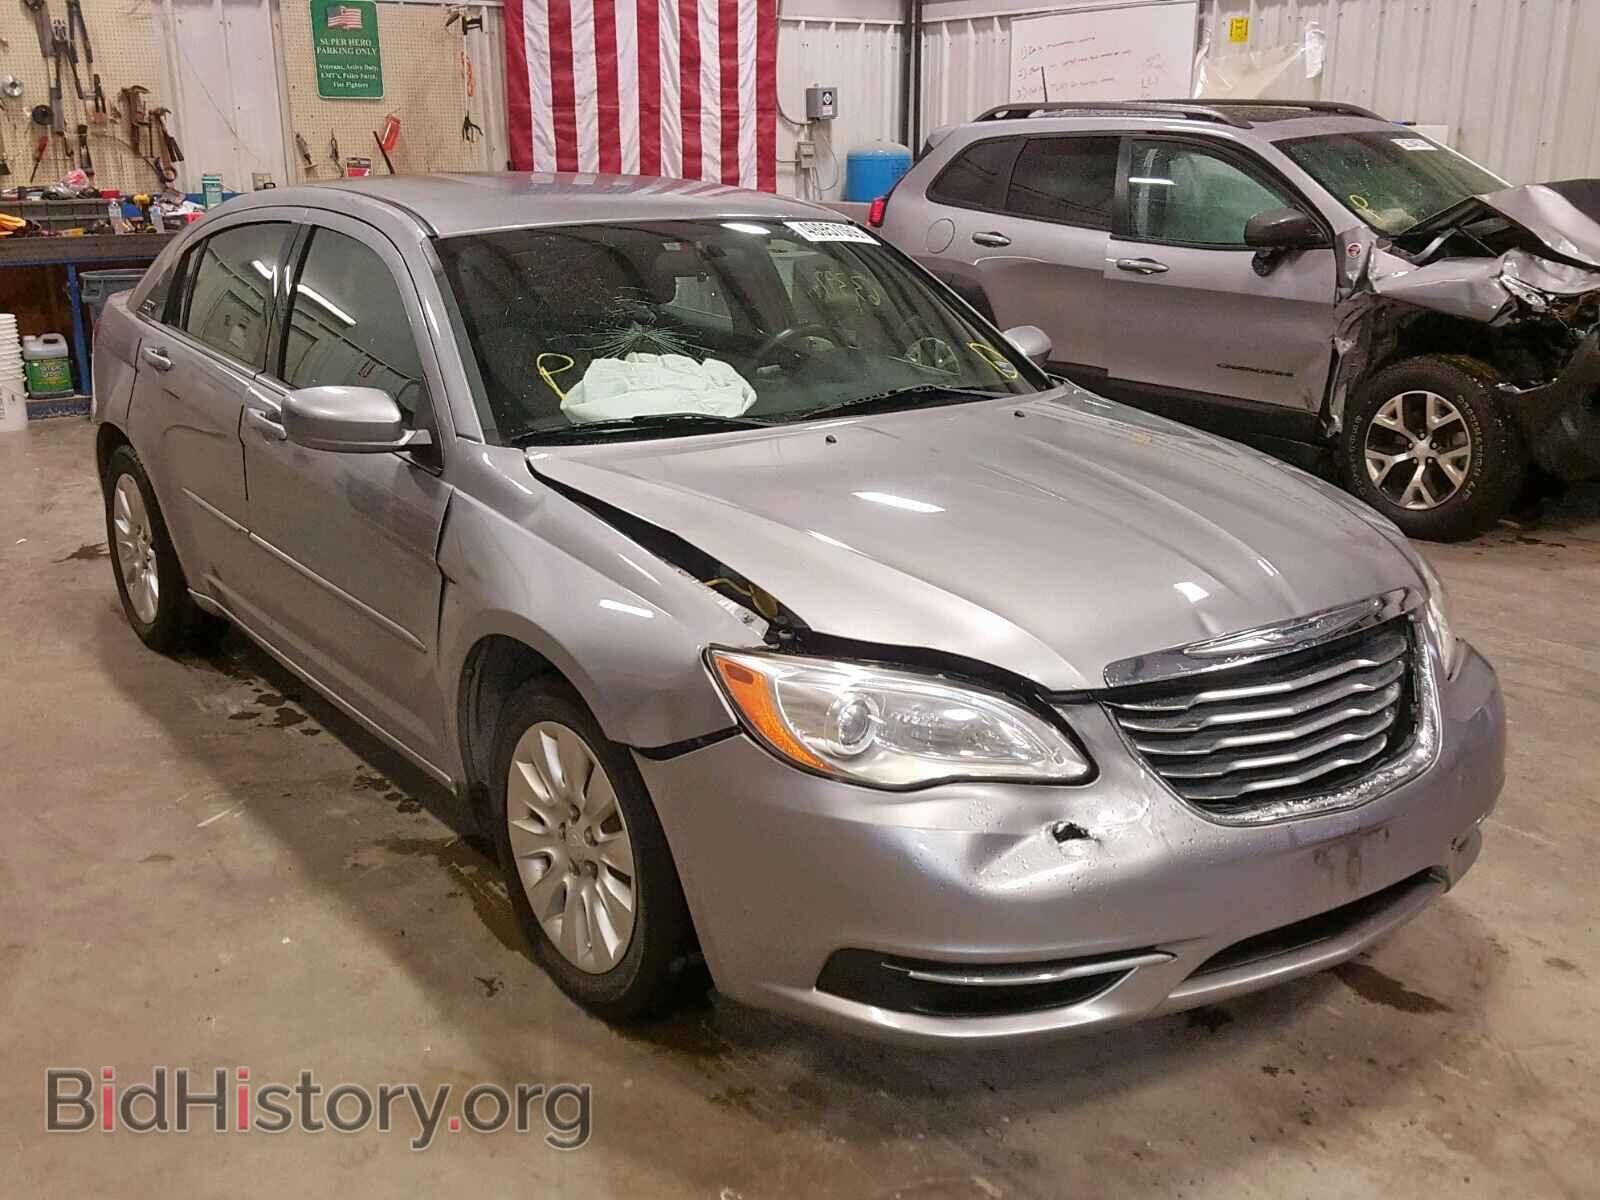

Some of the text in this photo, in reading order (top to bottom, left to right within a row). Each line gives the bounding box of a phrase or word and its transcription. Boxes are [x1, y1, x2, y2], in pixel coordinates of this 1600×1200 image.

[320, 38, 372, 47] SUPER HERO
[316, 46, 377, 56] PARKING ONLY
